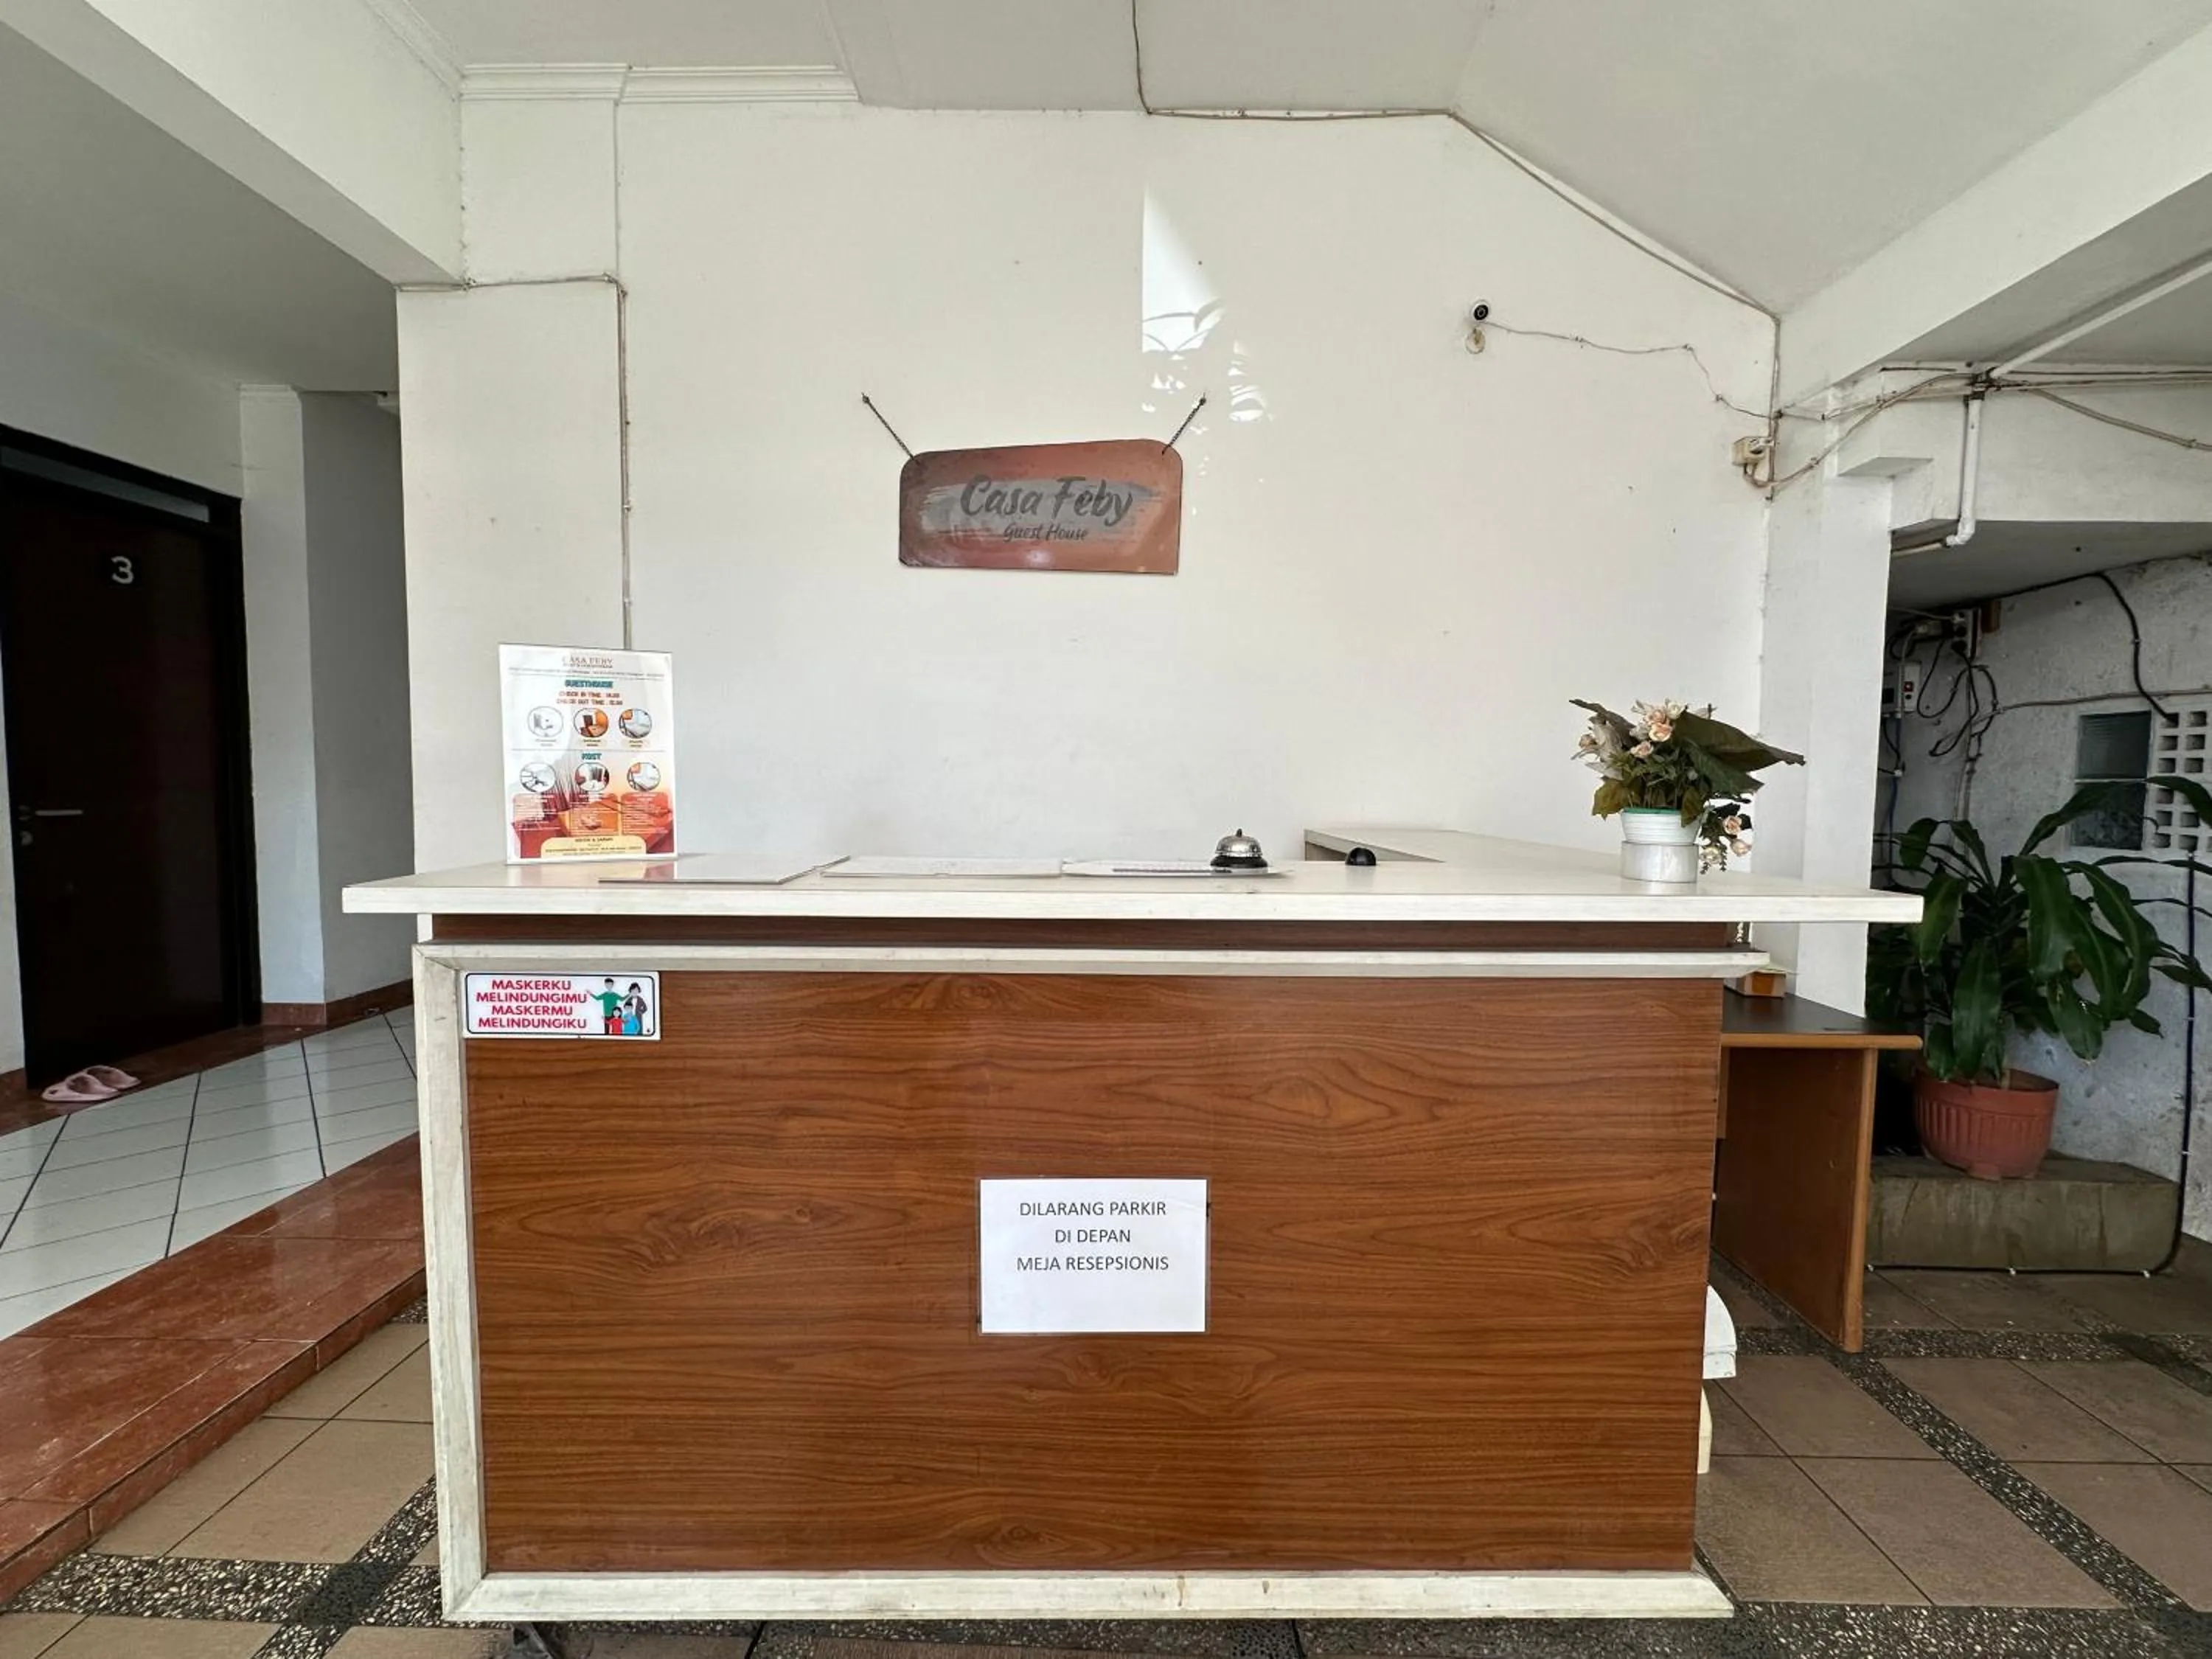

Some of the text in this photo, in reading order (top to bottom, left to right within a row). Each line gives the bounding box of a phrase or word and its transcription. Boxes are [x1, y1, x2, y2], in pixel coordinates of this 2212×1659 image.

[960, 473, 1133, 527] Casa Feby
[1003, 521, 1088, 543] Guest House
[111, 555, 134, 584] 3
[492, 979, 571, 990] MASKERKU
[476, 992, 587, 1004] MELINDUNGIMU
[491, 1005, 573, 1016] MASKERMU
[479, 1017, 587, 1029] MELINDUNGIKU
[1020, 1202, 1166, 1216] DILARANG PARKIR
[1055, 1229, 1131, 1243] DI DEPAN
[1017, 1256, 1169, 1271] MEJA RESEPSIONIS
